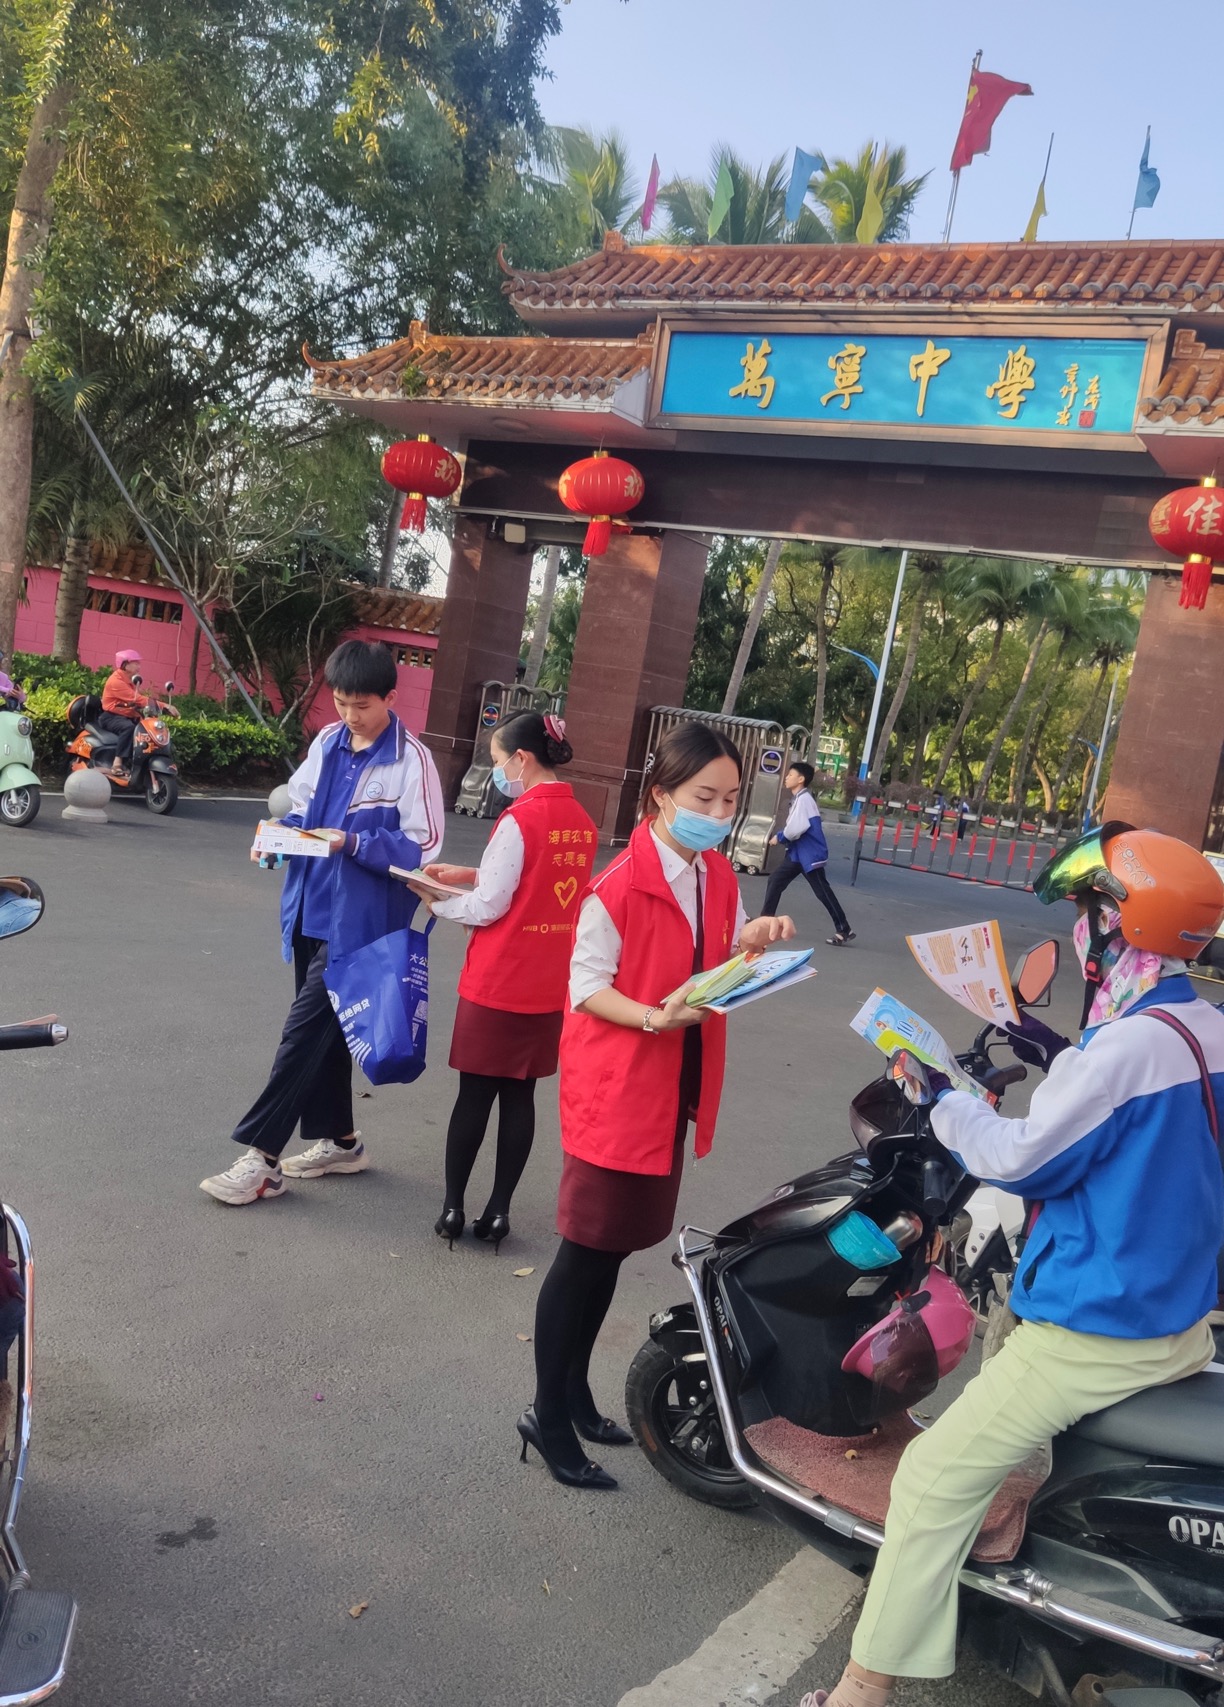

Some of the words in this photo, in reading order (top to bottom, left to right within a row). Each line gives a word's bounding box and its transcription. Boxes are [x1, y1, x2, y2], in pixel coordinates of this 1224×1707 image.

[1182, 495, 1223, 536] 佳
[552, 851, 587, 867] 志愿者
[410, 953, 428, 967] 大公
[1168, 1515, 1224, 1548] OPA
